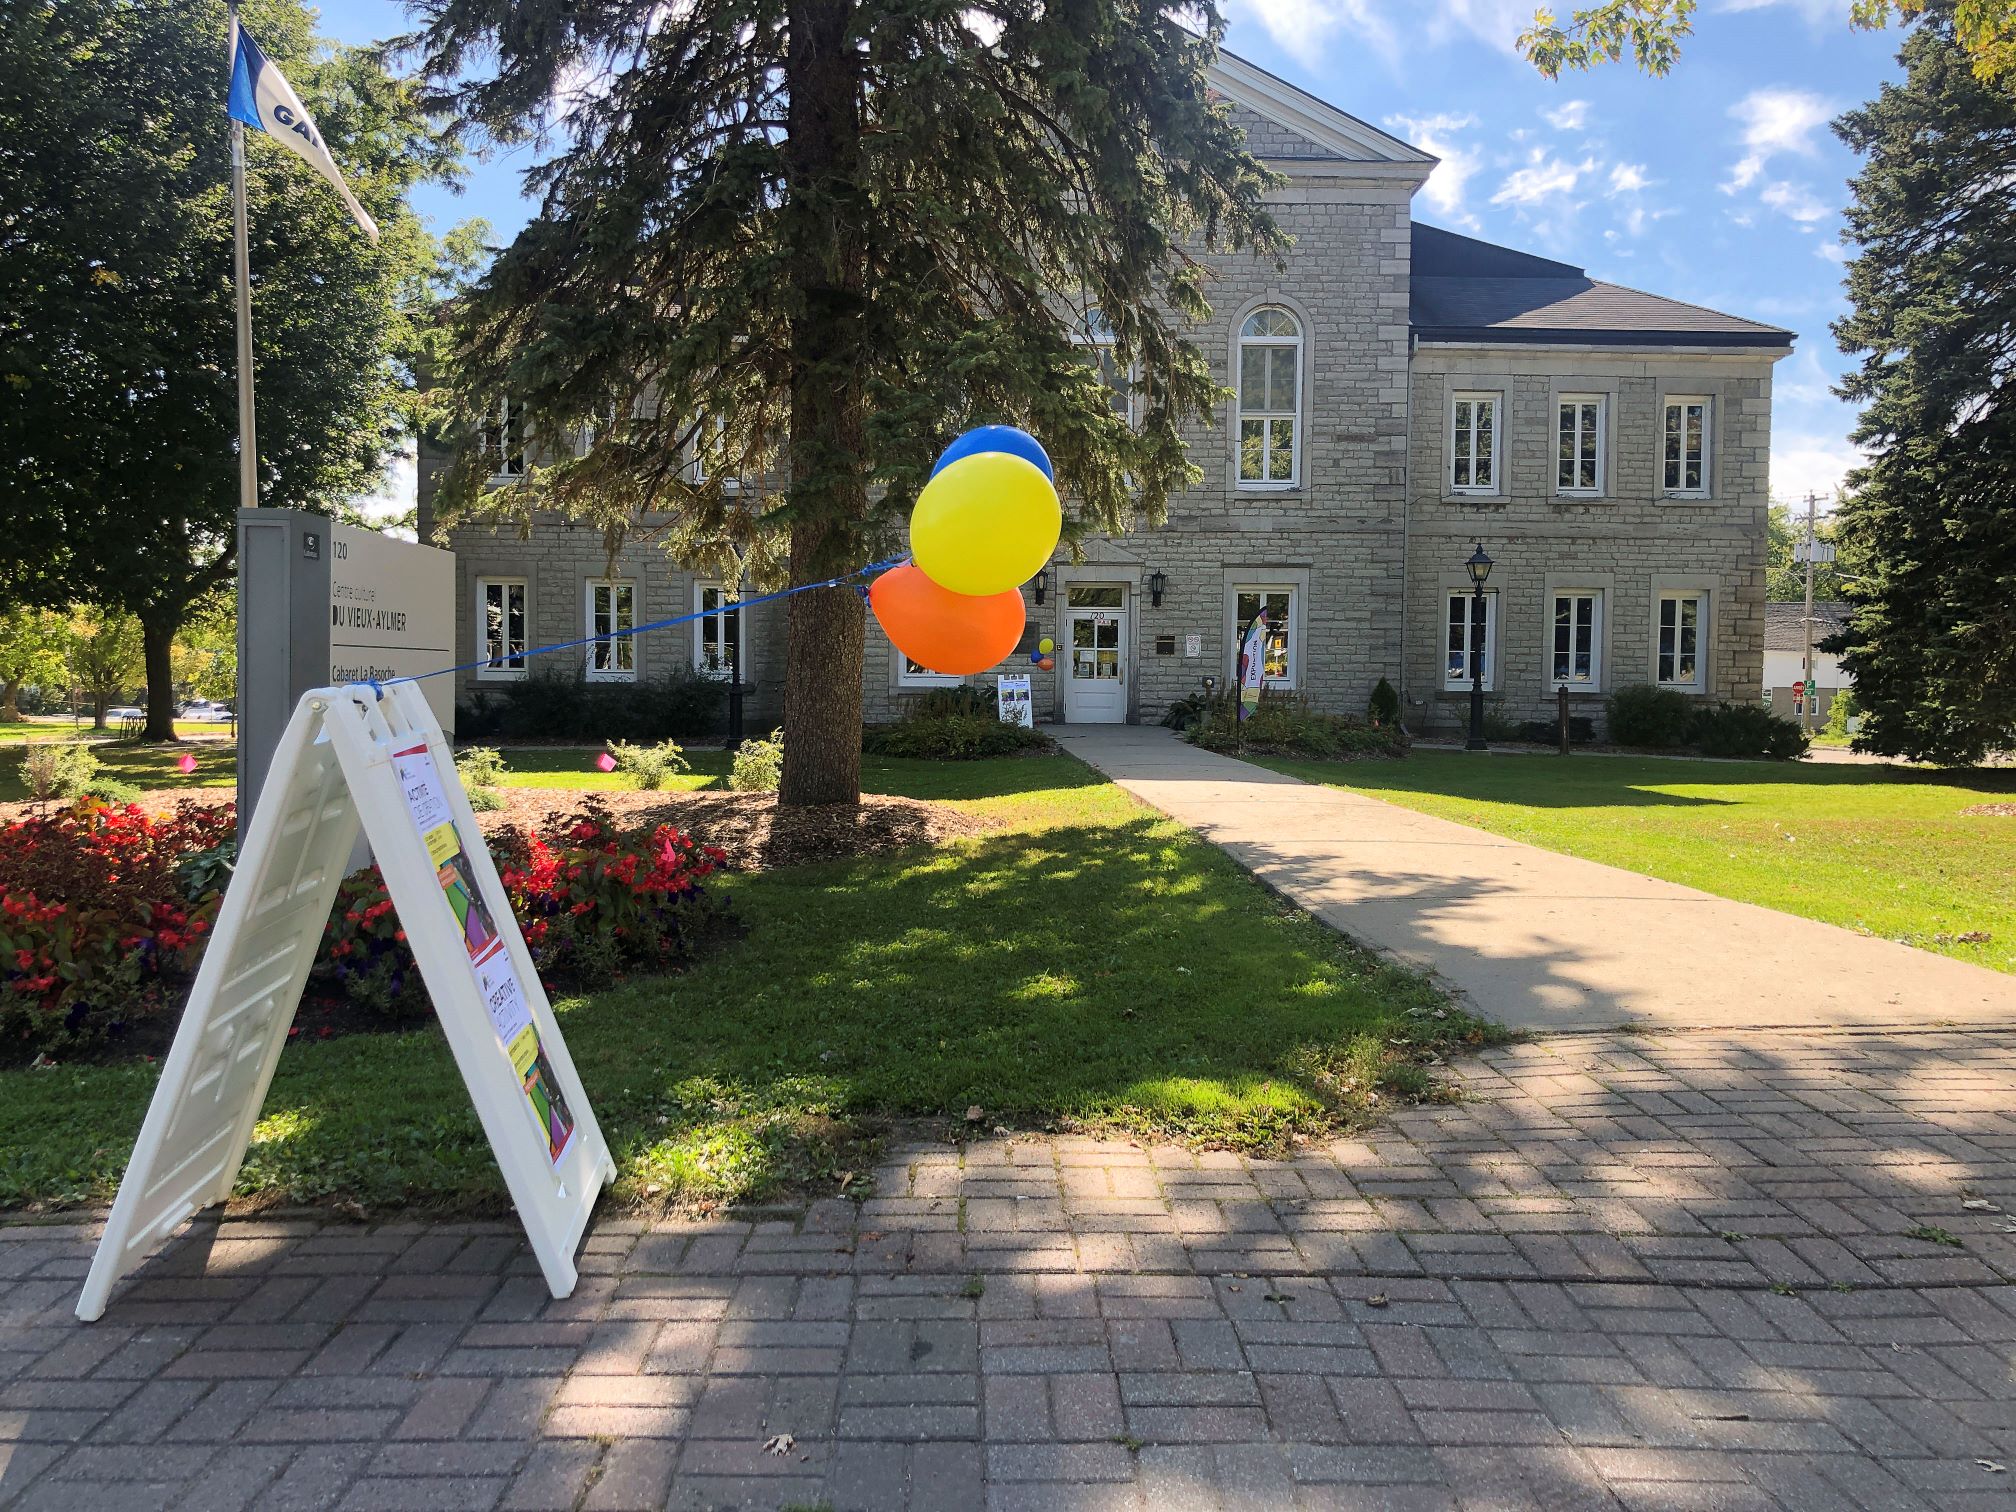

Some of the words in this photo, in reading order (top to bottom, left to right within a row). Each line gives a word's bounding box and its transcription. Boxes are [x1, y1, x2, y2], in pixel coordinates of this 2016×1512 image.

[333, 541, 348, 560] 120
[332, 604, 345, 627] DU
[332, 665, 359, 682] Cabaret
[360, 665, 368, 682] La
